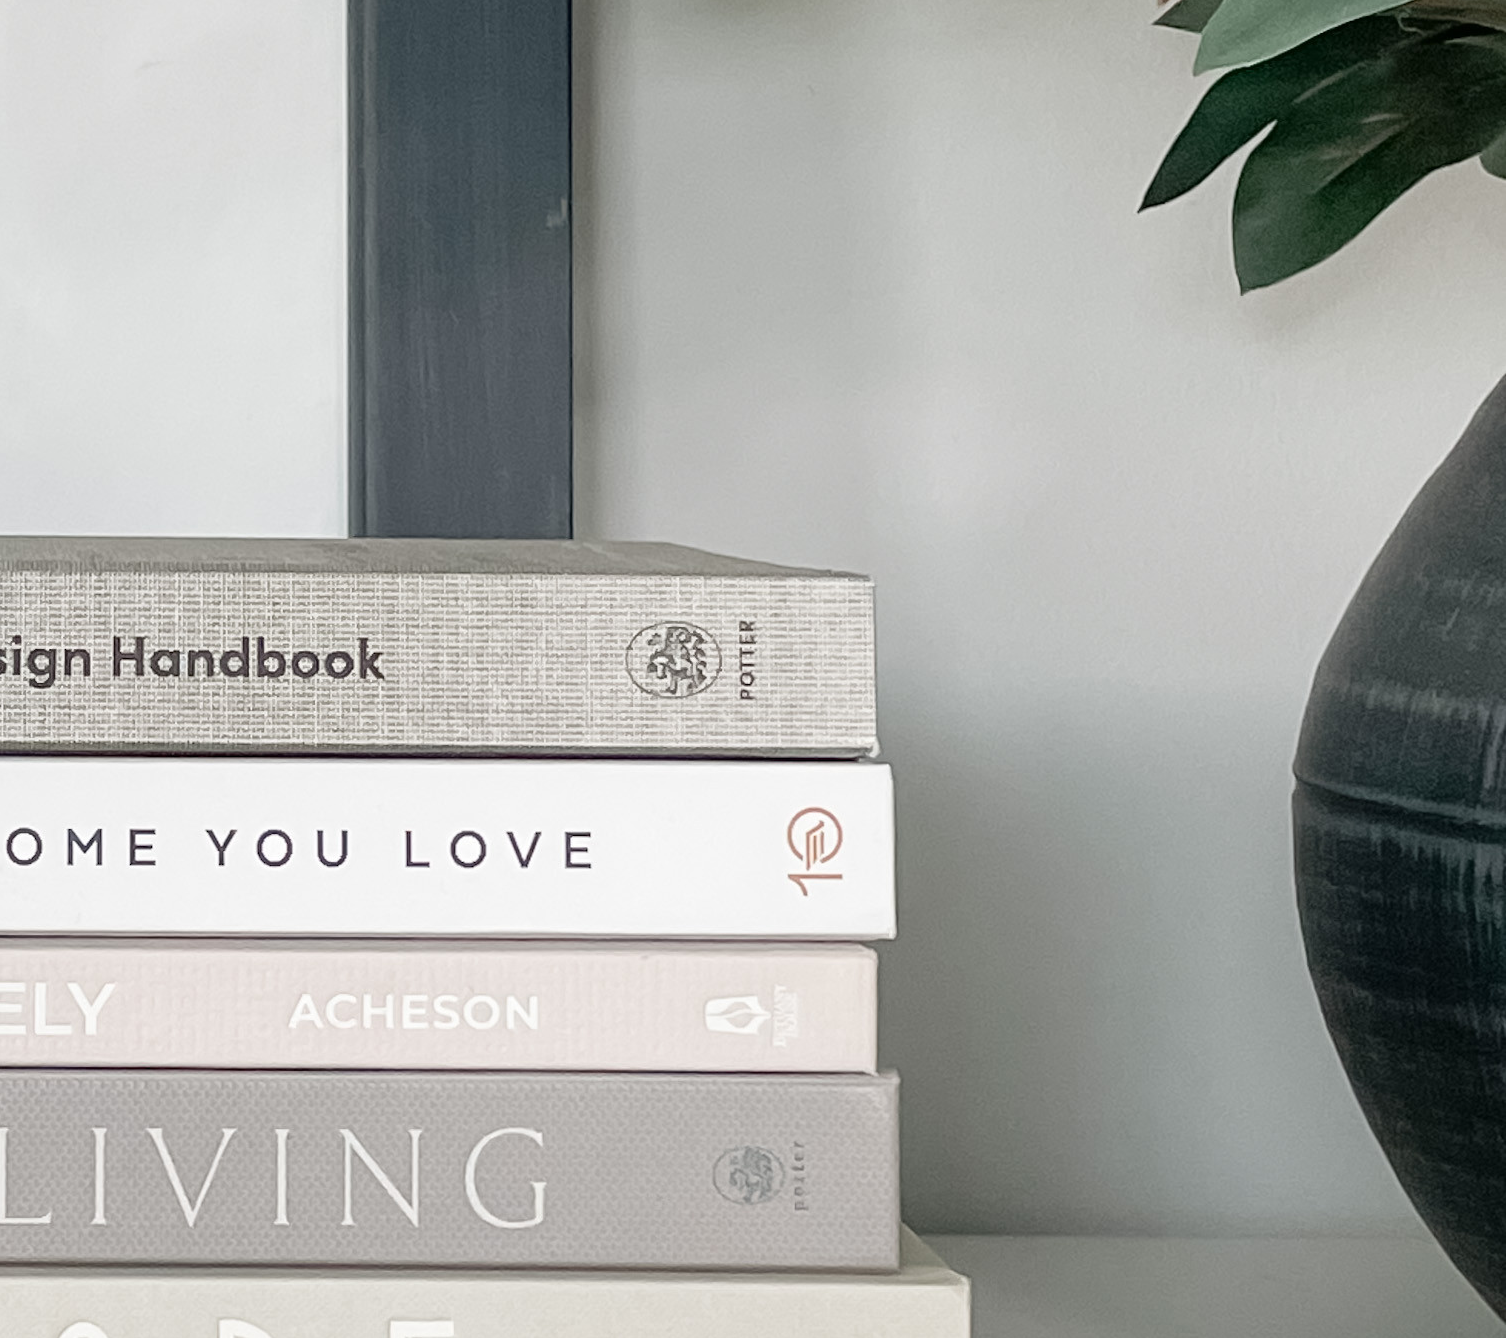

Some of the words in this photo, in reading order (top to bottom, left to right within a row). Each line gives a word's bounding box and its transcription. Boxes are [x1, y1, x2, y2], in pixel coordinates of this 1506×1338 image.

[111, 635, 386, 681] Handbook
[738, 619, 758, 701] POTTER
[205, 828, 350, 869] YOU
[404, 830, 593, 870] LOVE
[287, 993, 540, 1032] ACHESON
[791, 1140, 810, 1212] potter
